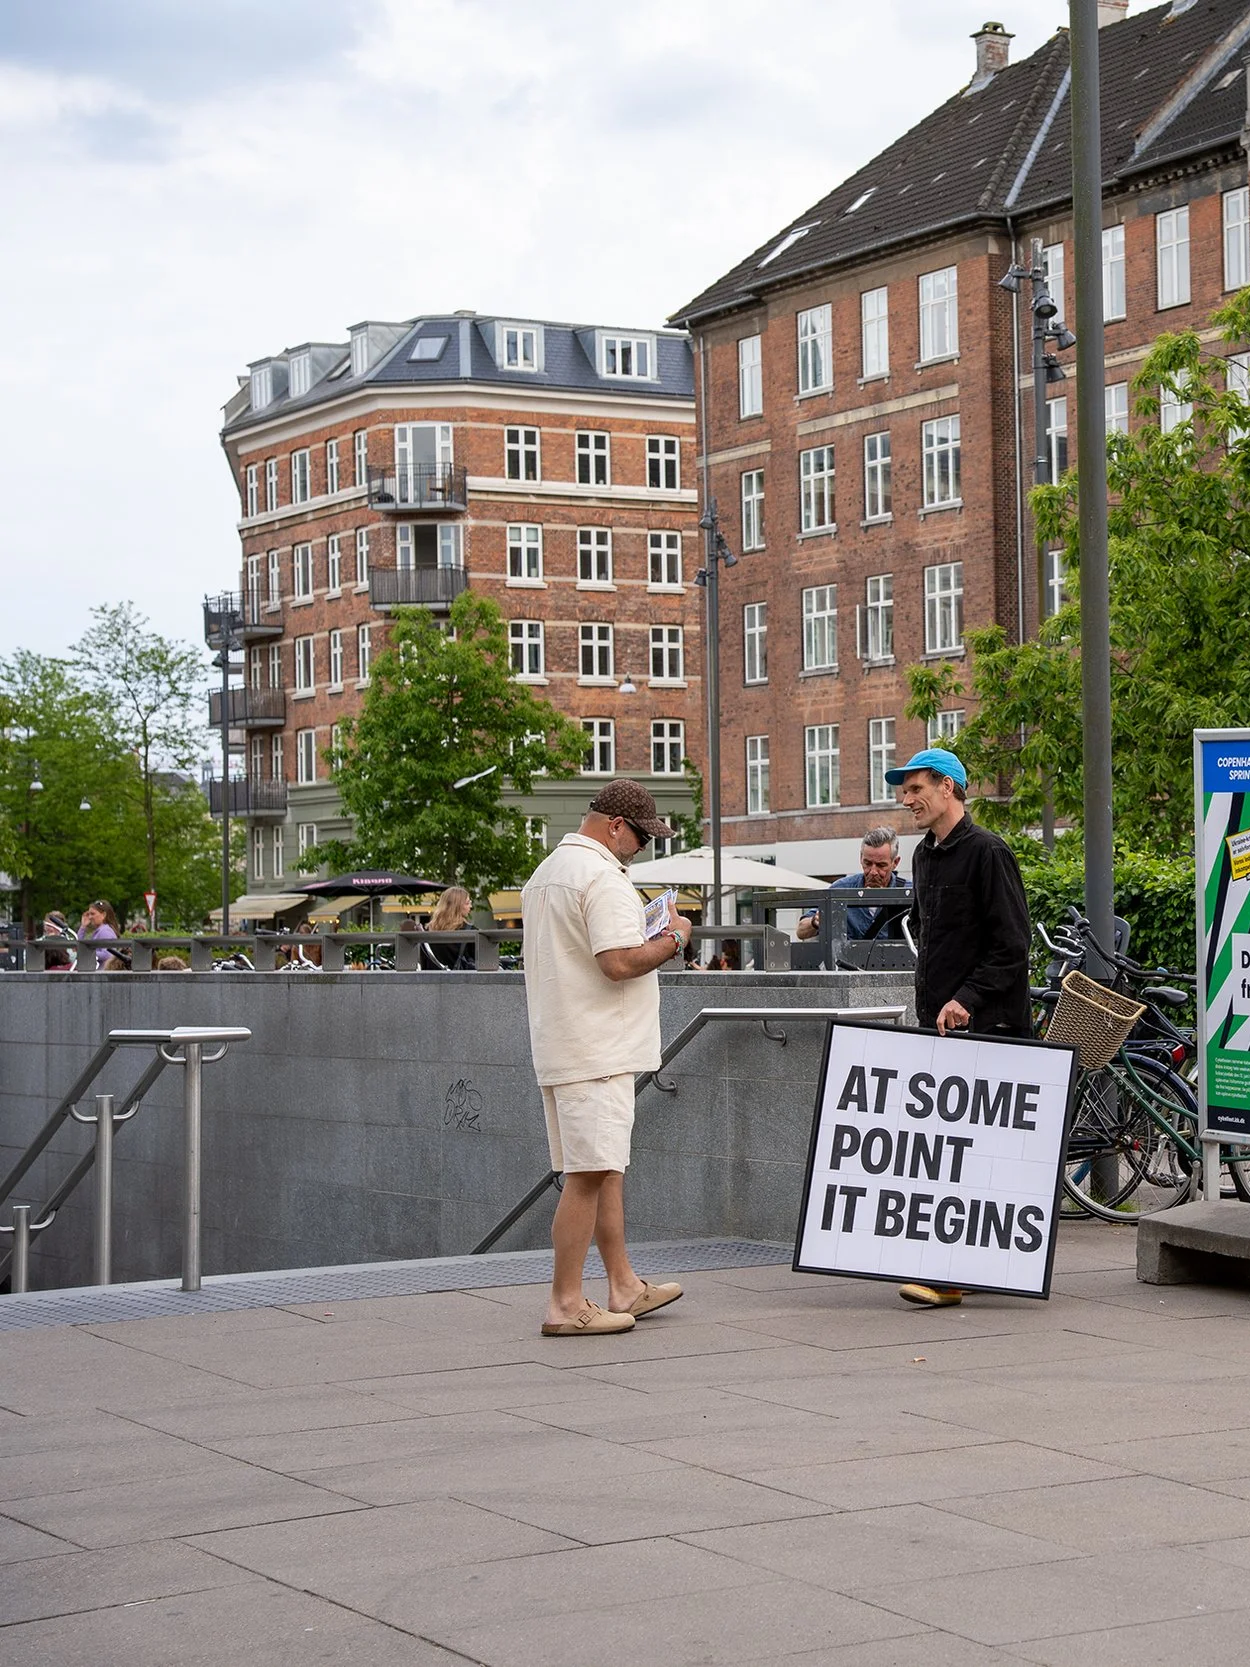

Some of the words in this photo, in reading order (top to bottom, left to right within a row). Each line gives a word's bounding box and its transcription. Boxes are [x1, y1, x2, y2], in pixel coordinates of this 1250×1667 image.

[837, 1065, 899, 1114] AT
[905, 1072, 1041, 1131] SOME
[829, 1124, 974, 1183] POINT
[820, 1184, 867, 1233] IT
[874, 1189, 1044, 1253] BEGINS
